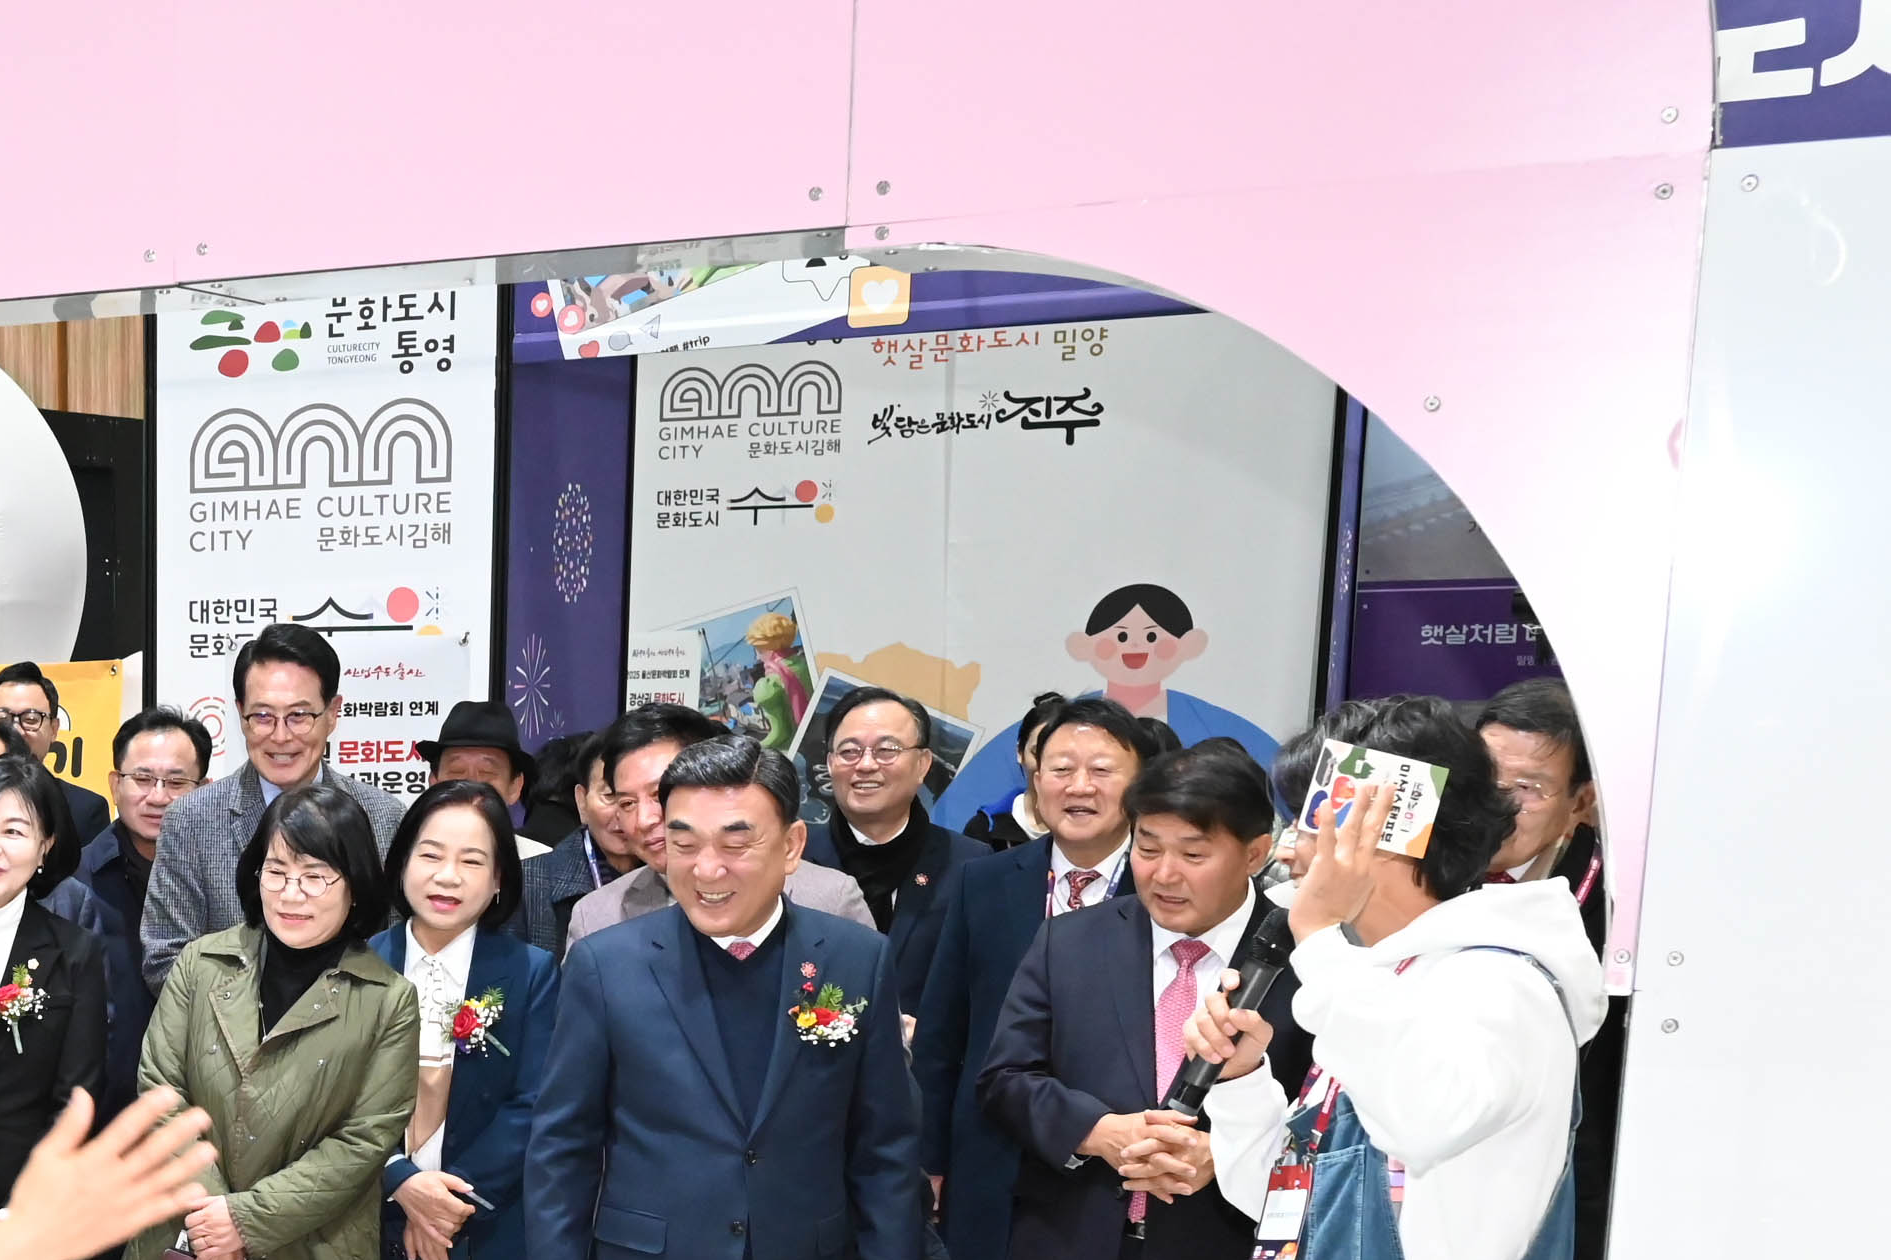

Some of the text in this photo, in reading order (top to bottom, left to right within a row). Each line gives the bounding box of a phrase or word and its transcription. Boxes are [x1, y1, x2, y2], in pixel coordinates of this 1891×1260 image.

[325, 290, 456, 338] 문화도시
[327, 341, 381, 353] CULTURECITY
[391, 330, 455, 374] 통영
[682, 334, 710, 351] #trip
[871, 327, 1109, 370] 햇살문화도시 밀양
[327, 353, 377, 365] TONGYEONG
[995, 386, 1105, 446] 진주
[659, 418, 842, 441] GIMHAE CULTURE
[659, 439, 841, 460] CITY 문화도시김해
[189, 491, 453, 523] GIMHAE CULTURE
[656, 488, 720, 506] 대한민국
[656, 511, 720, 529] 문화도시
[189, 521, 453, 552] CITY 문화도시김해
[188, 598, 278, 624] 대한민국
[1420, 623, 1518, 645] 햇살처럼
[409, 700, 439, 717] 연계
